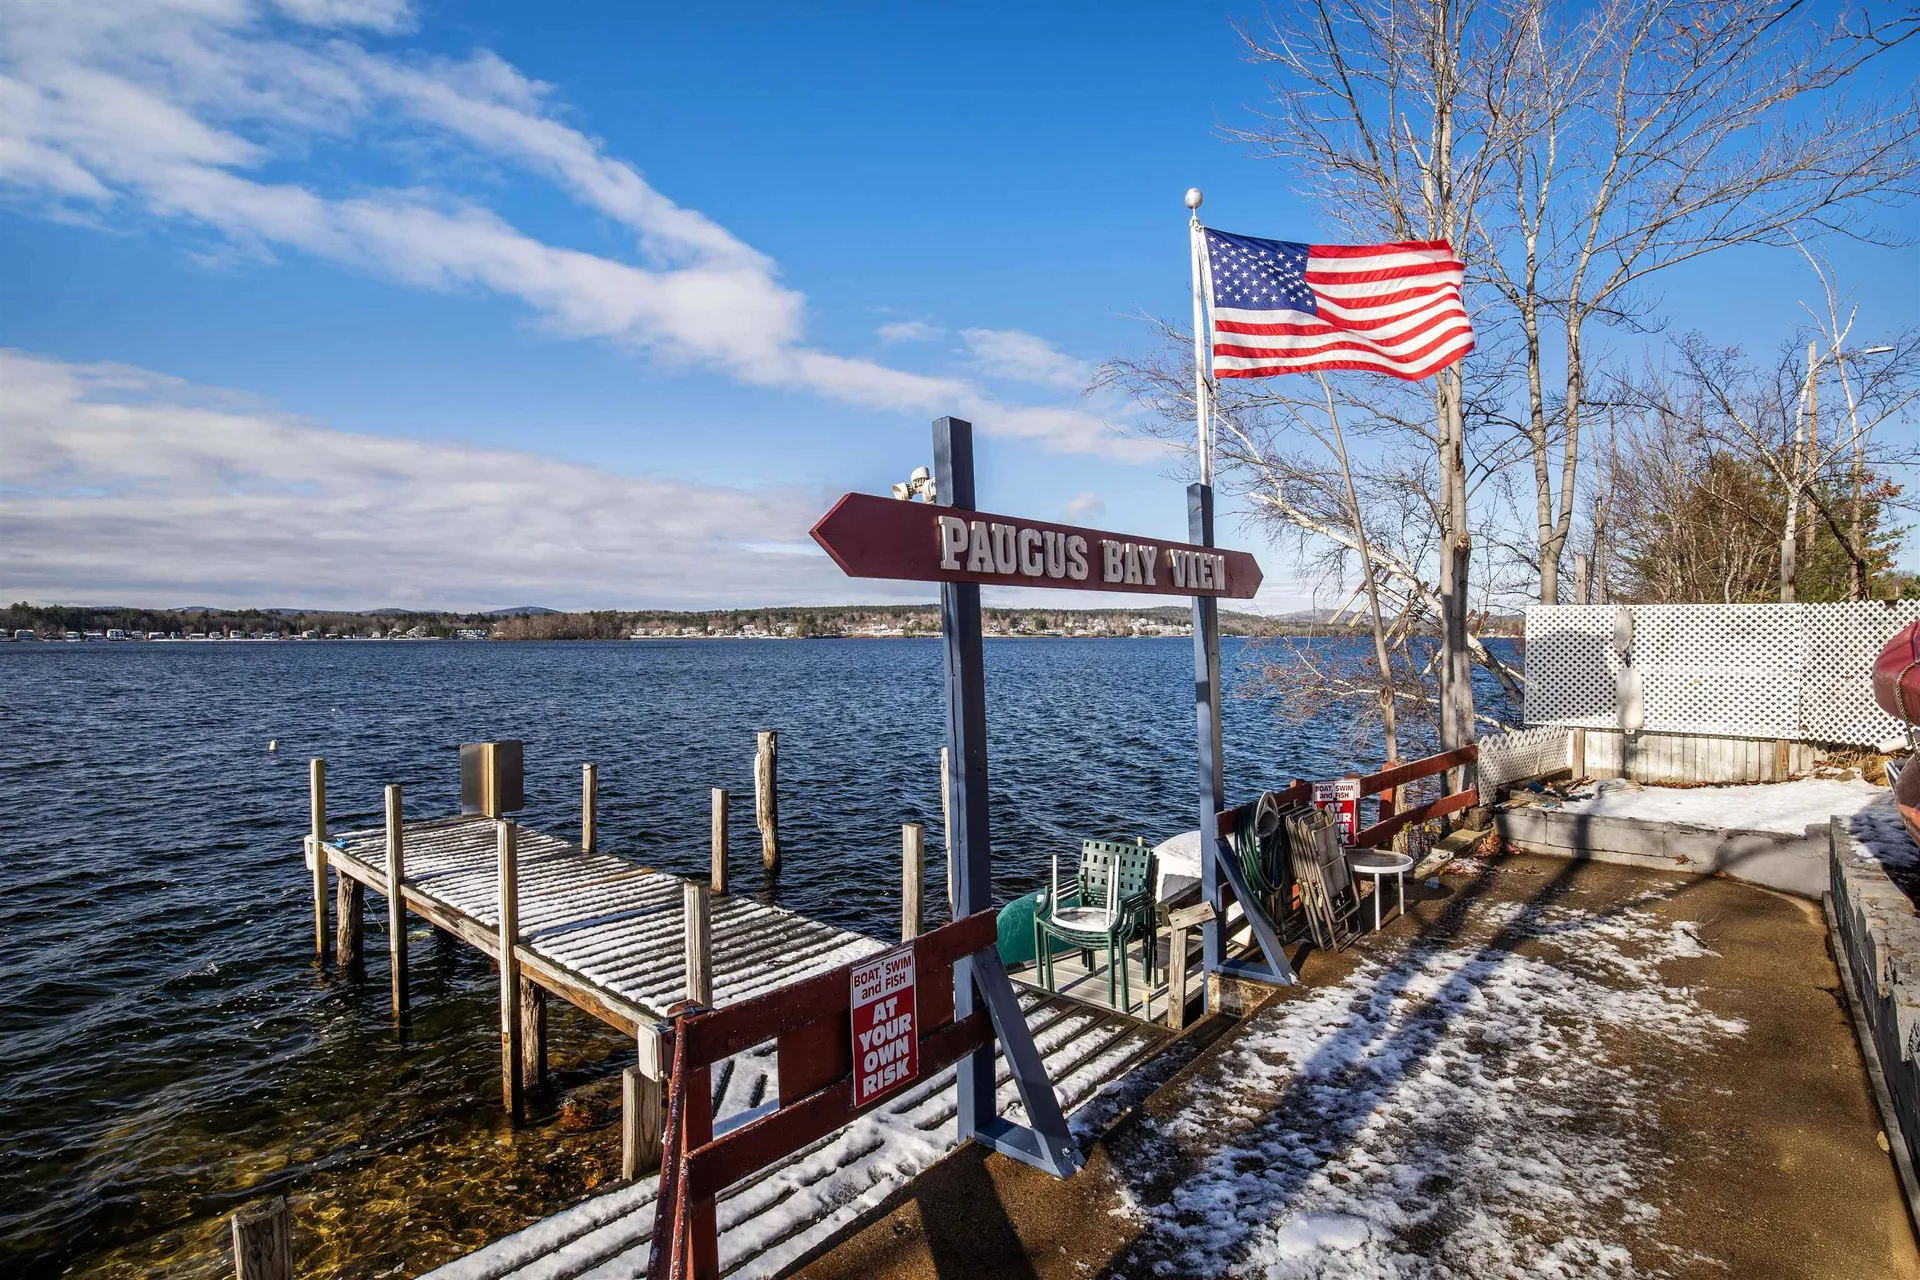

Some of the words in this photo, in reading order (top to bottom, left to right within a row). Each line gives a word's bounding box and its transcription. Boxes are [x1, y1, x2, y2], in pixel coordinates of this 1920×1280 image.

[938, 515, 1088, 580] PAUGUS
[1102, 539, 1157, 585] BAY
[1169, 548, 1225, 590] VIEW
[1335, 812, 1352, 823] UR
[854, 967, 882, 988] BOAT,
[885, 955, 912, 975] SWIM
[861, 981, 882, 1000] and
[885, 971, 906, 990] FISH
[872, 996, 898, 1025] AT
[858, 1013, 912, 1052] YOUR
[863, 1035, 909, 1073] OWN
[863, 1056, 910, 1098] RISK
